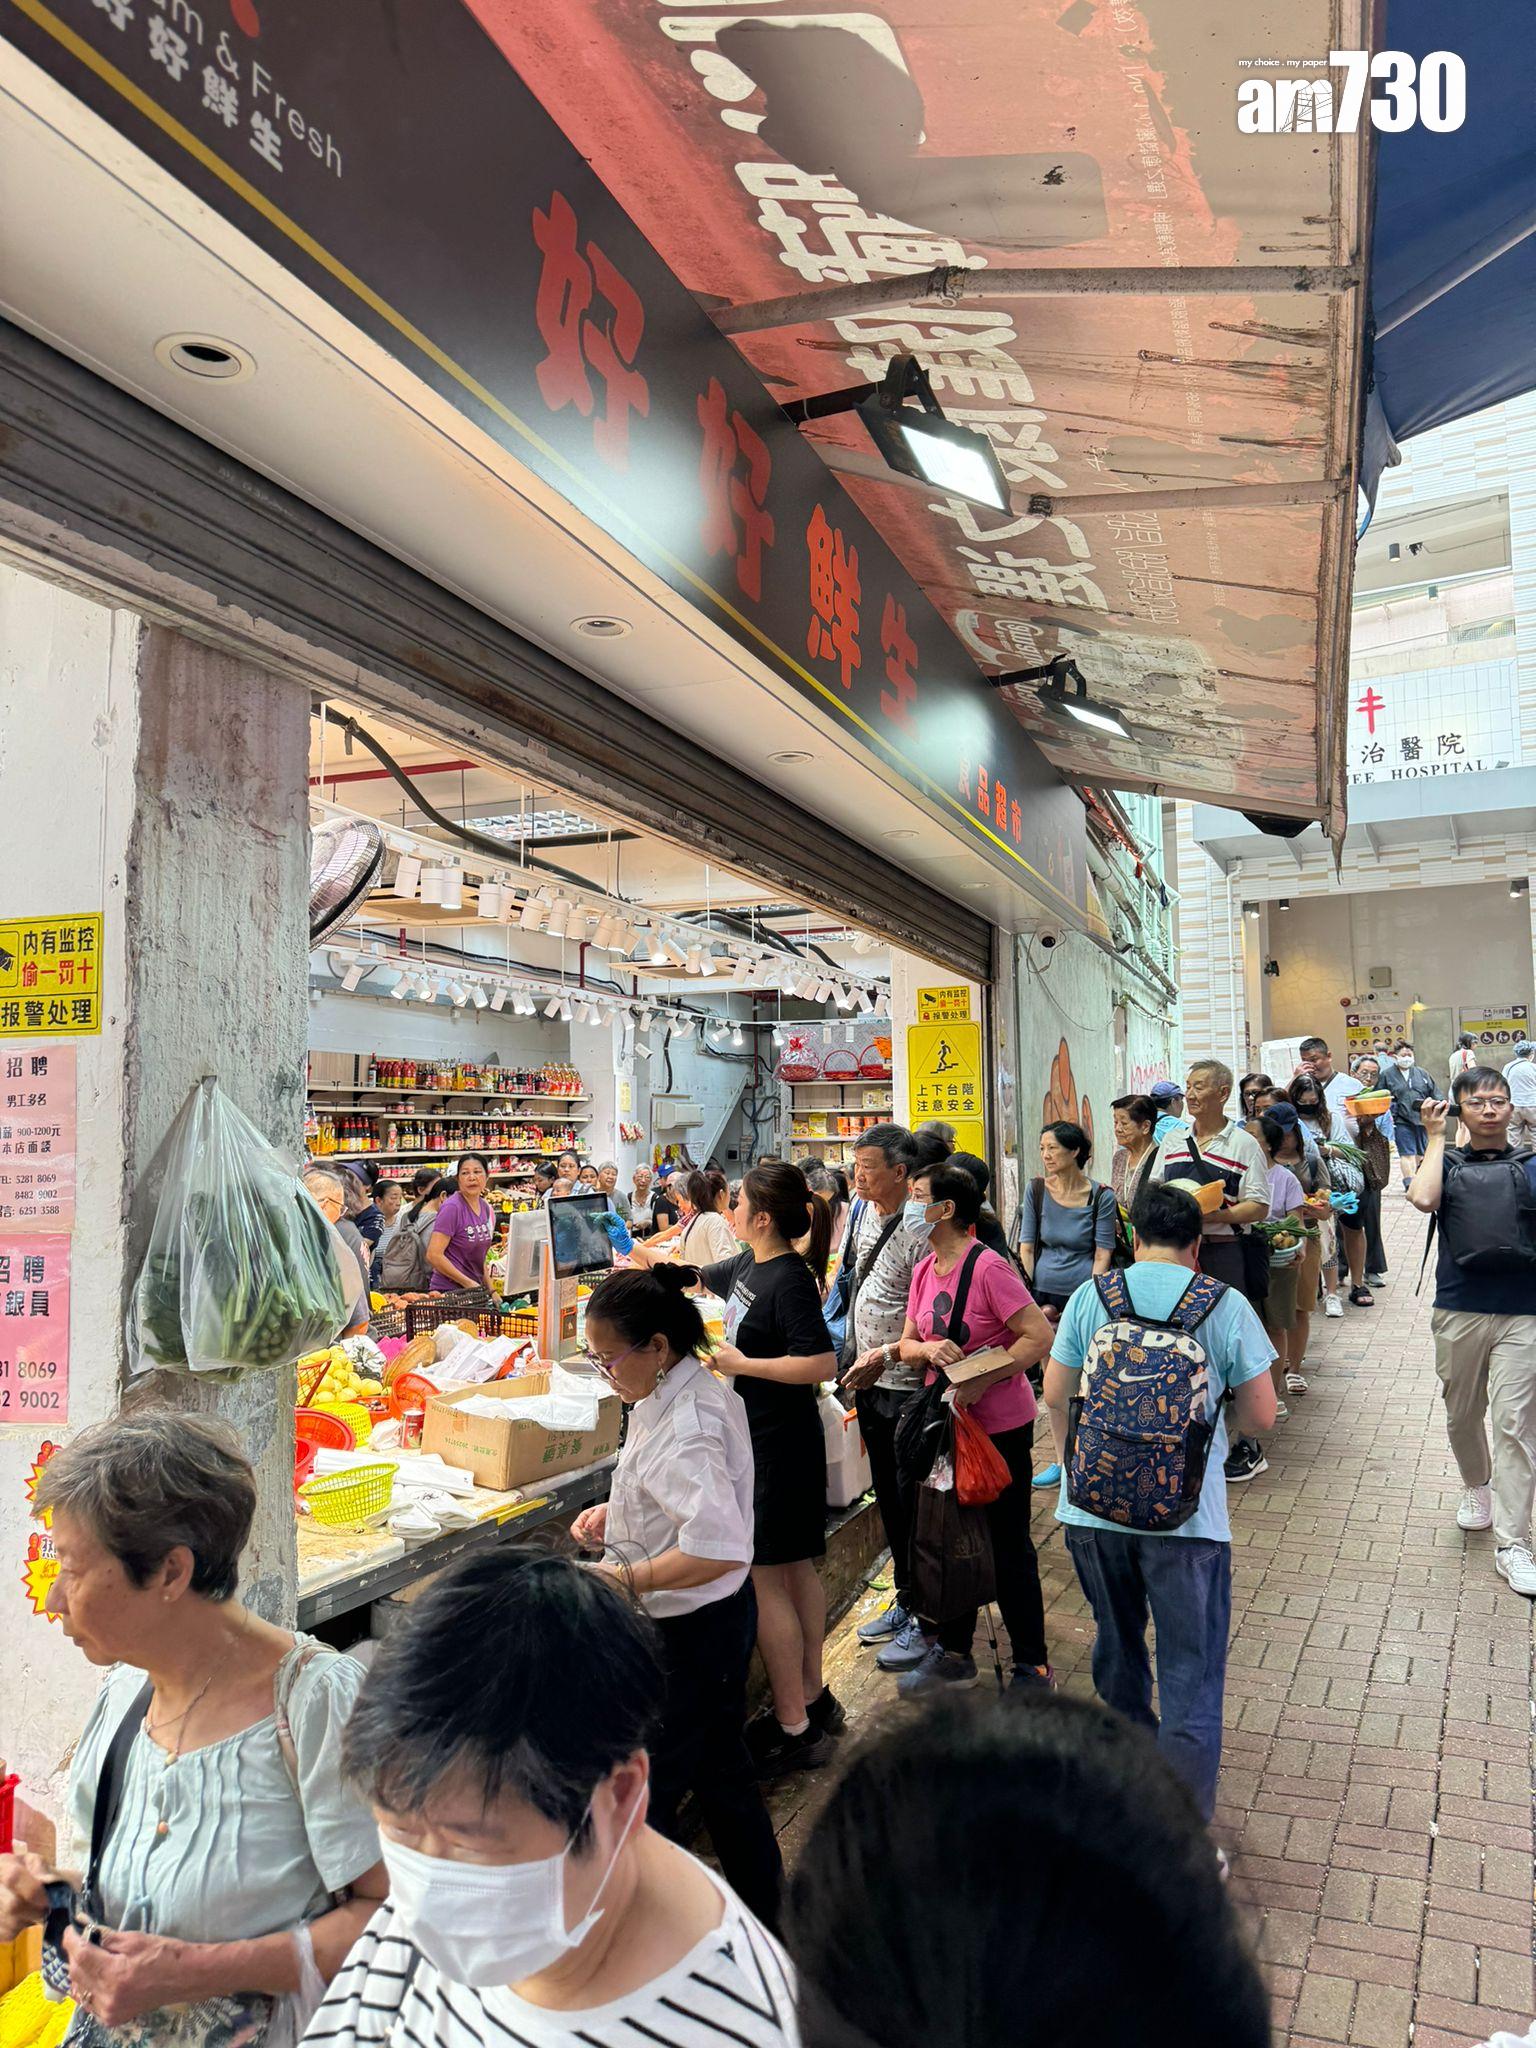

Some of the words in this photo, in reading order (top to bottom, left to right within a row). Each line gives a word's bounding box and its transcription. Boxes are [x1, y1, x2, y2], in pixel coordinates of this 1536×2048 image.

[154, 0, 204, 46] m
[215, 30, 239, 81] &
[252, 60, 342, 178] Fresh
[531, 189, 919, 745] 好好鮮生
[1361, 732, 1465, 765] 治醫院
[1391, 759, 1488, 780] HOSPITAL
[22, 926, 95, 956] 内有监控
[21, 957, 94, 988] 偷一罚十
[1, 998, 92, 1028] 报警处理
[6, 1056, 48, 1079] 招聘
[7, 1093, 47, 1108] 男工多名
[916, 1083, 974, 1097] 上下台階
[916, 1099, 975, 1112] 注意安全
[17, 1124, 61, 1137] 900-1200元
[15, 1175, 33, 1184] 5281
[37, 1174, 57, 1183] 8069
[15, 1190, 34, 1199] 8482
[38, 1190, 58, 1199] 9002
[19, 1207, 37, 1216] 6251
[41, 1205, 60, 1215] 3588
[0, 1290, 50, 1317] 銀員
[1141, 1330, 1206, 1364] DO
[17, 1361, 57, 1379] 8069
[20, 1390, 60, 1410] 9002
